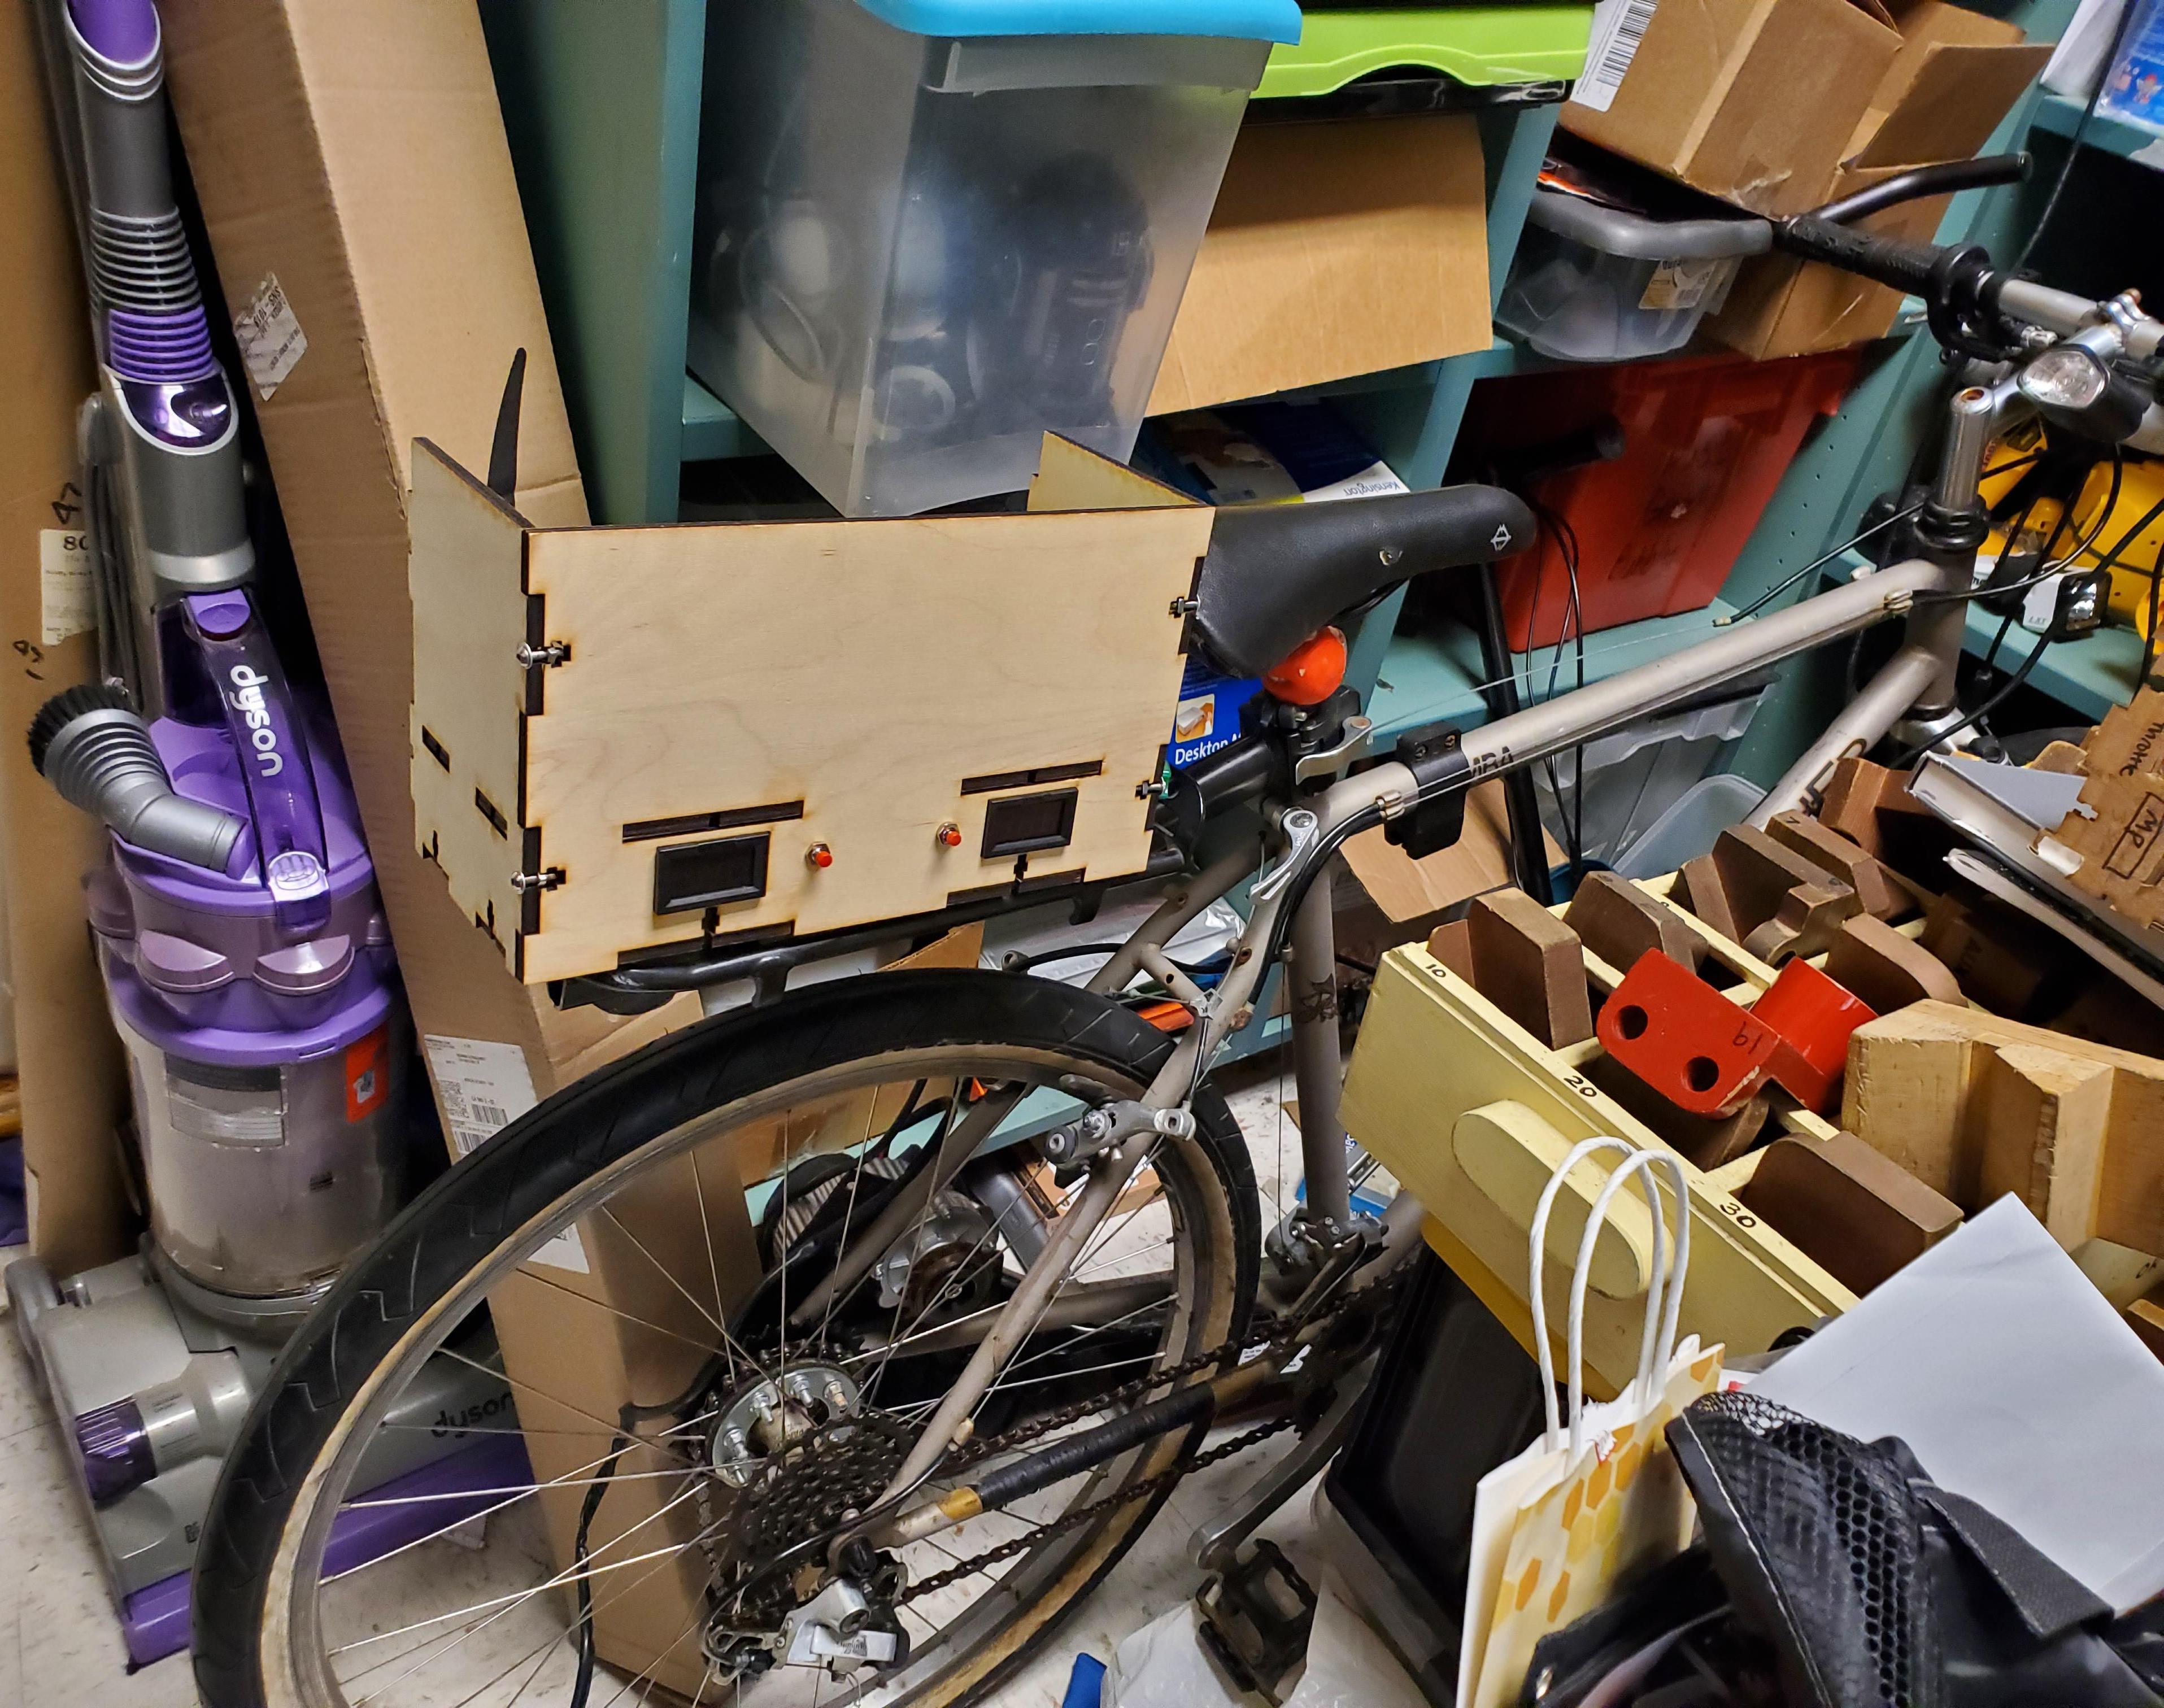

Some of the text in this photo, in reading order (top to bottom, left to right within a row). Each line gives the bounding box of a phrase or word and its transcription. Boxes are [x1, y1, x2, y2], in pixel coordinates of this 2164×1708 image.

[1344, 481, 1400, 496] Kensington
[230, 665, 283, 777] dyson
[2130, 806, 2159, 849] MP
[1425, 964, 1447, 978] 10
[1564, 1075, 1597, 1097] 20
[1719, 1202, 1757, 1228] 30
[430, 1391, 515, 1439] dyson
